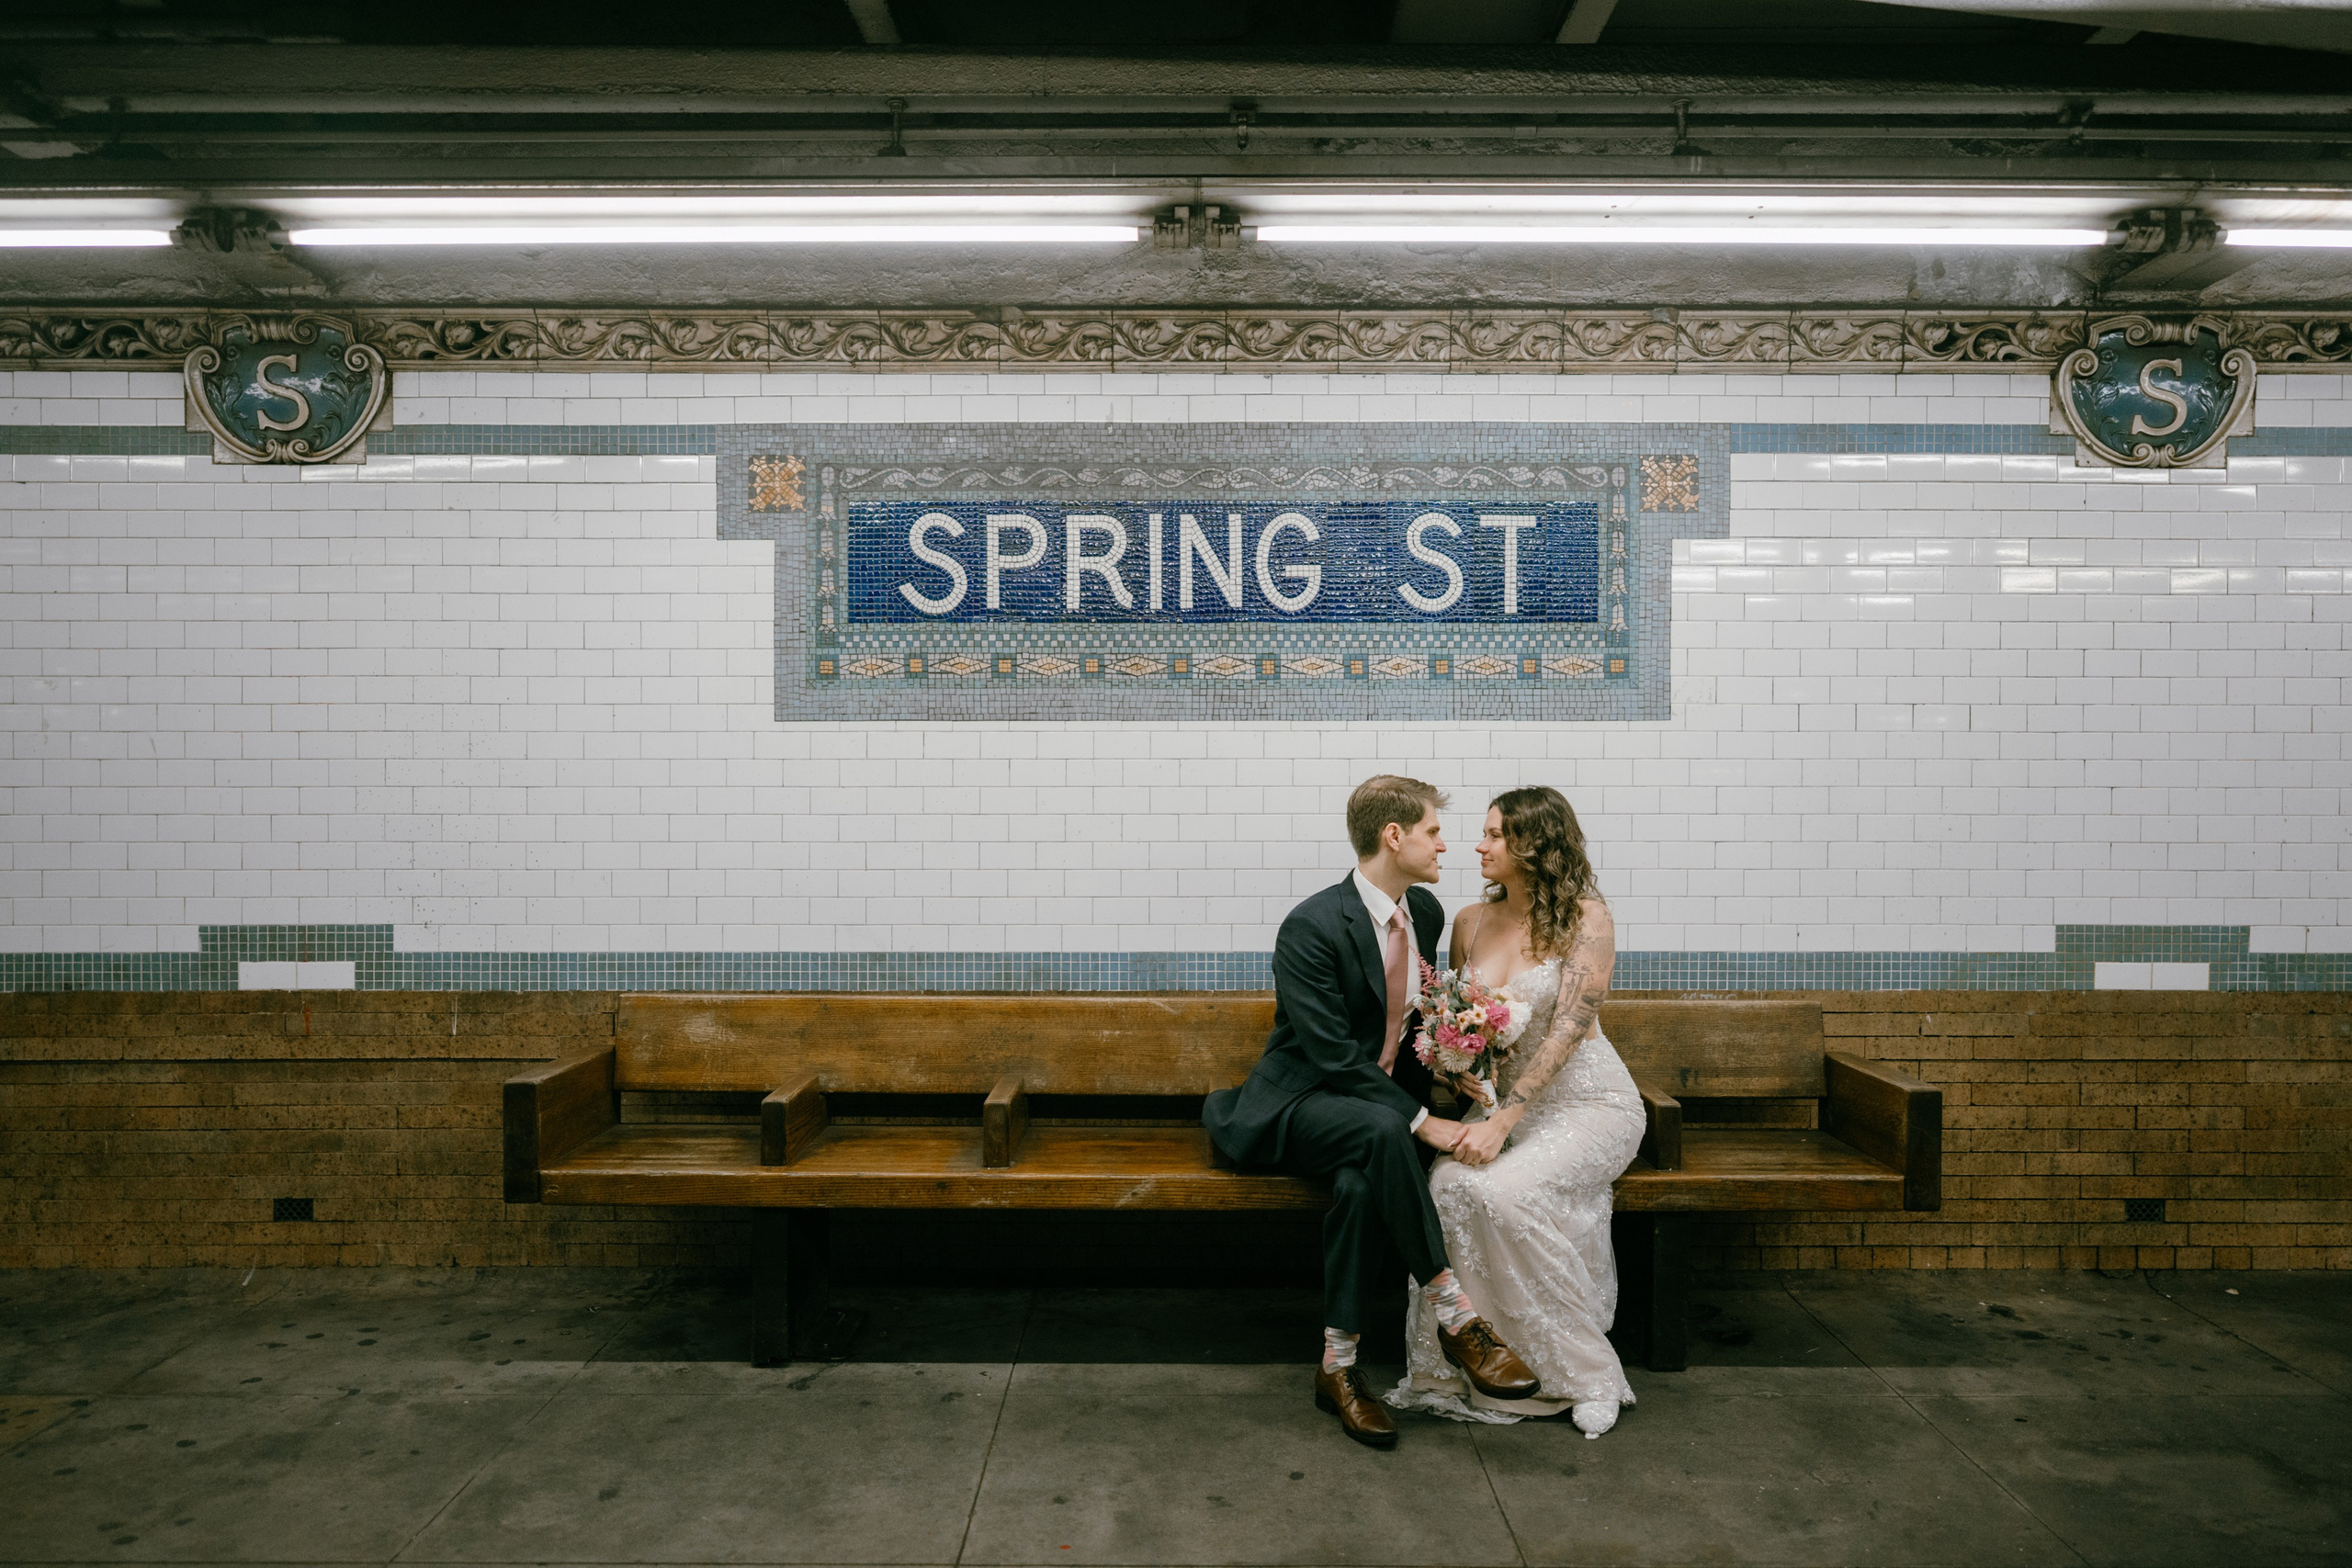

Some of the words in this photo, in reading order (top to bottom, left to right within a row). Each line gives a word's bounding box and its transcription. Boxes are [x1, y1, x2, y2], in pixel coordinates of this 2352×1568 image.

[256, 354, 310, 432] S
[2132, 358, 2188, 436] S
[899, 512, 1322, 615] SPRING
[1397, 512, 1537, 615] ST
